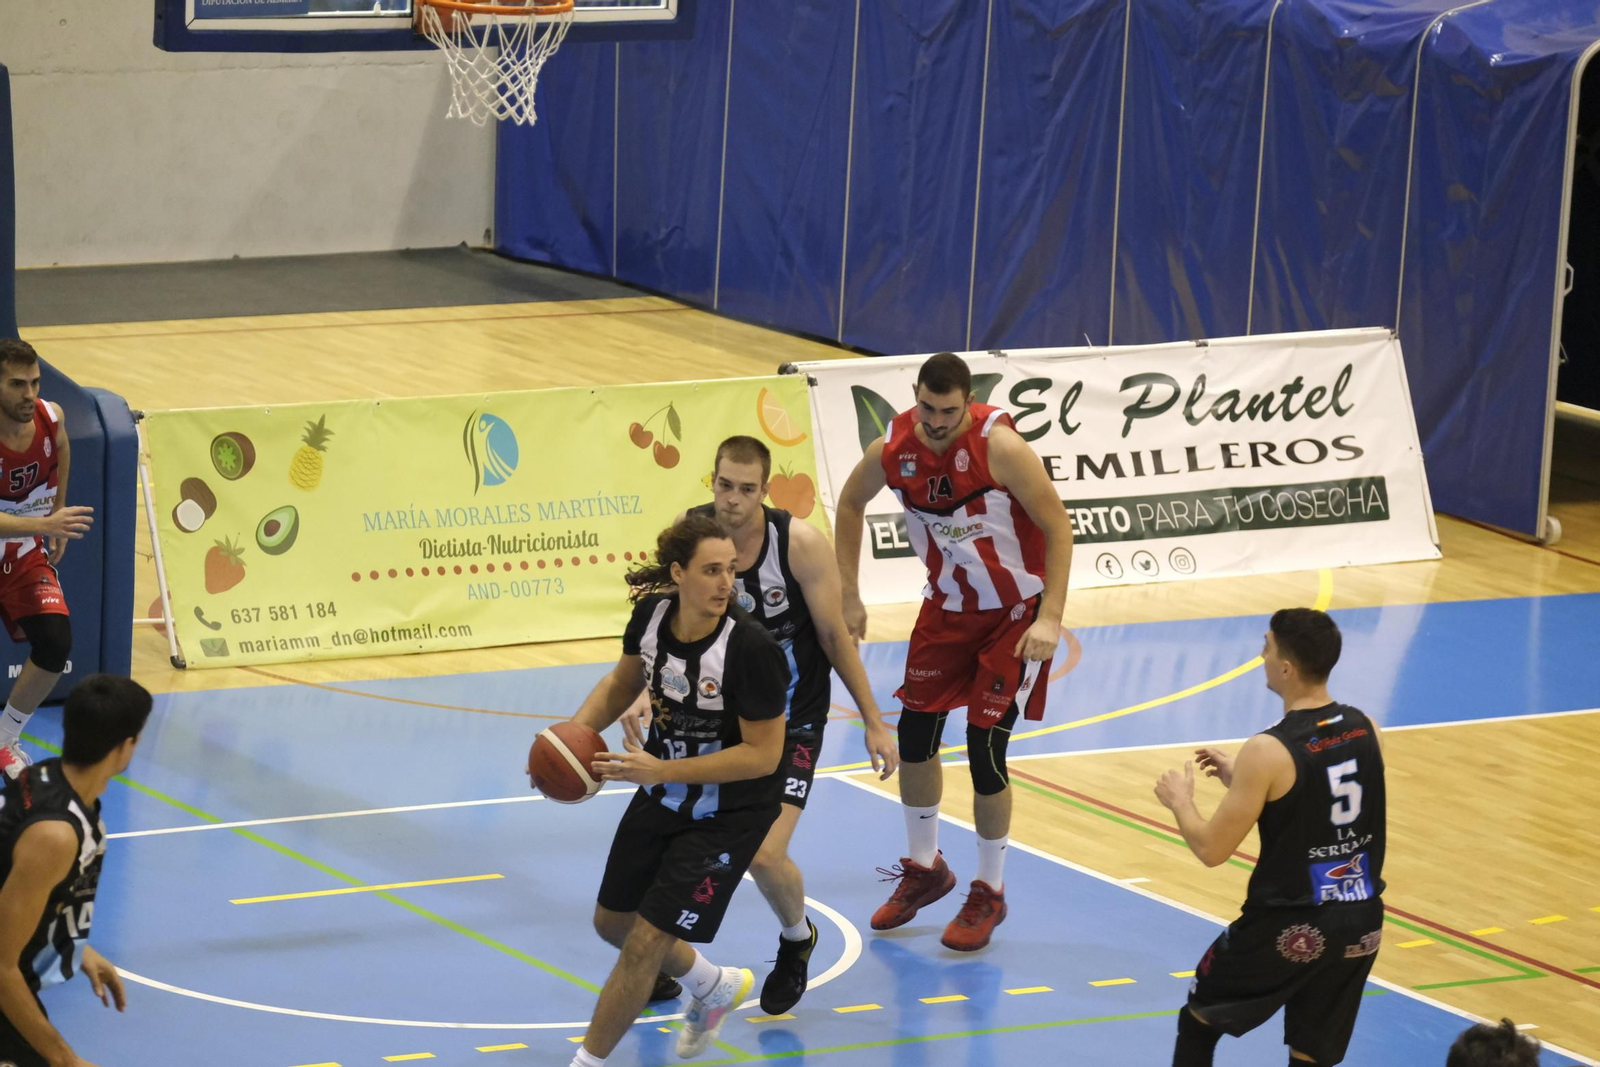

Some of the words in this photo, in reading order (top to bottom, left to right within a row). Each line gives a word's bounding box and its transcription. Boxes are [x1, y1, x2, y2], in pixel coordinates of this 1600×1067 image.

[1008, 376, 1084, 442] El
[1119, 363, 1355, 439] Plantel
[1041, 435, 1364, 482] EMILLEROS
[9, 461, 40, 493] 57
[362, 503, 432, 532] MARÍA
[435, 503, 532, 528] MORALES
[537, 490, 643, 521] MARTÍNEZ
[872, 521, 910, 550] EL
[1065, 505, 1131, 535] ERTO
[1136, 498, 1213, 532] PARA
[1213, 494, 1254, 523] TU
[1259, 483, 1386, 522] COSECHA
[419, 529, 600, 560] Dietista-Nutricionista
[468, 577, 565, 601] AND-00773
[231, 607, 261, 624] 637
[269, 604, 298, 622] 581
[306, 601, 338, 619] 184
[239, 622, 473, 654] mariamm_dn@hotmail.com
[784, 777, 807, 799] 23
[1327, 758, 1363, 826] 5
[62, 901, 94, 939] 14
[675, 909, 699, 931] 12
